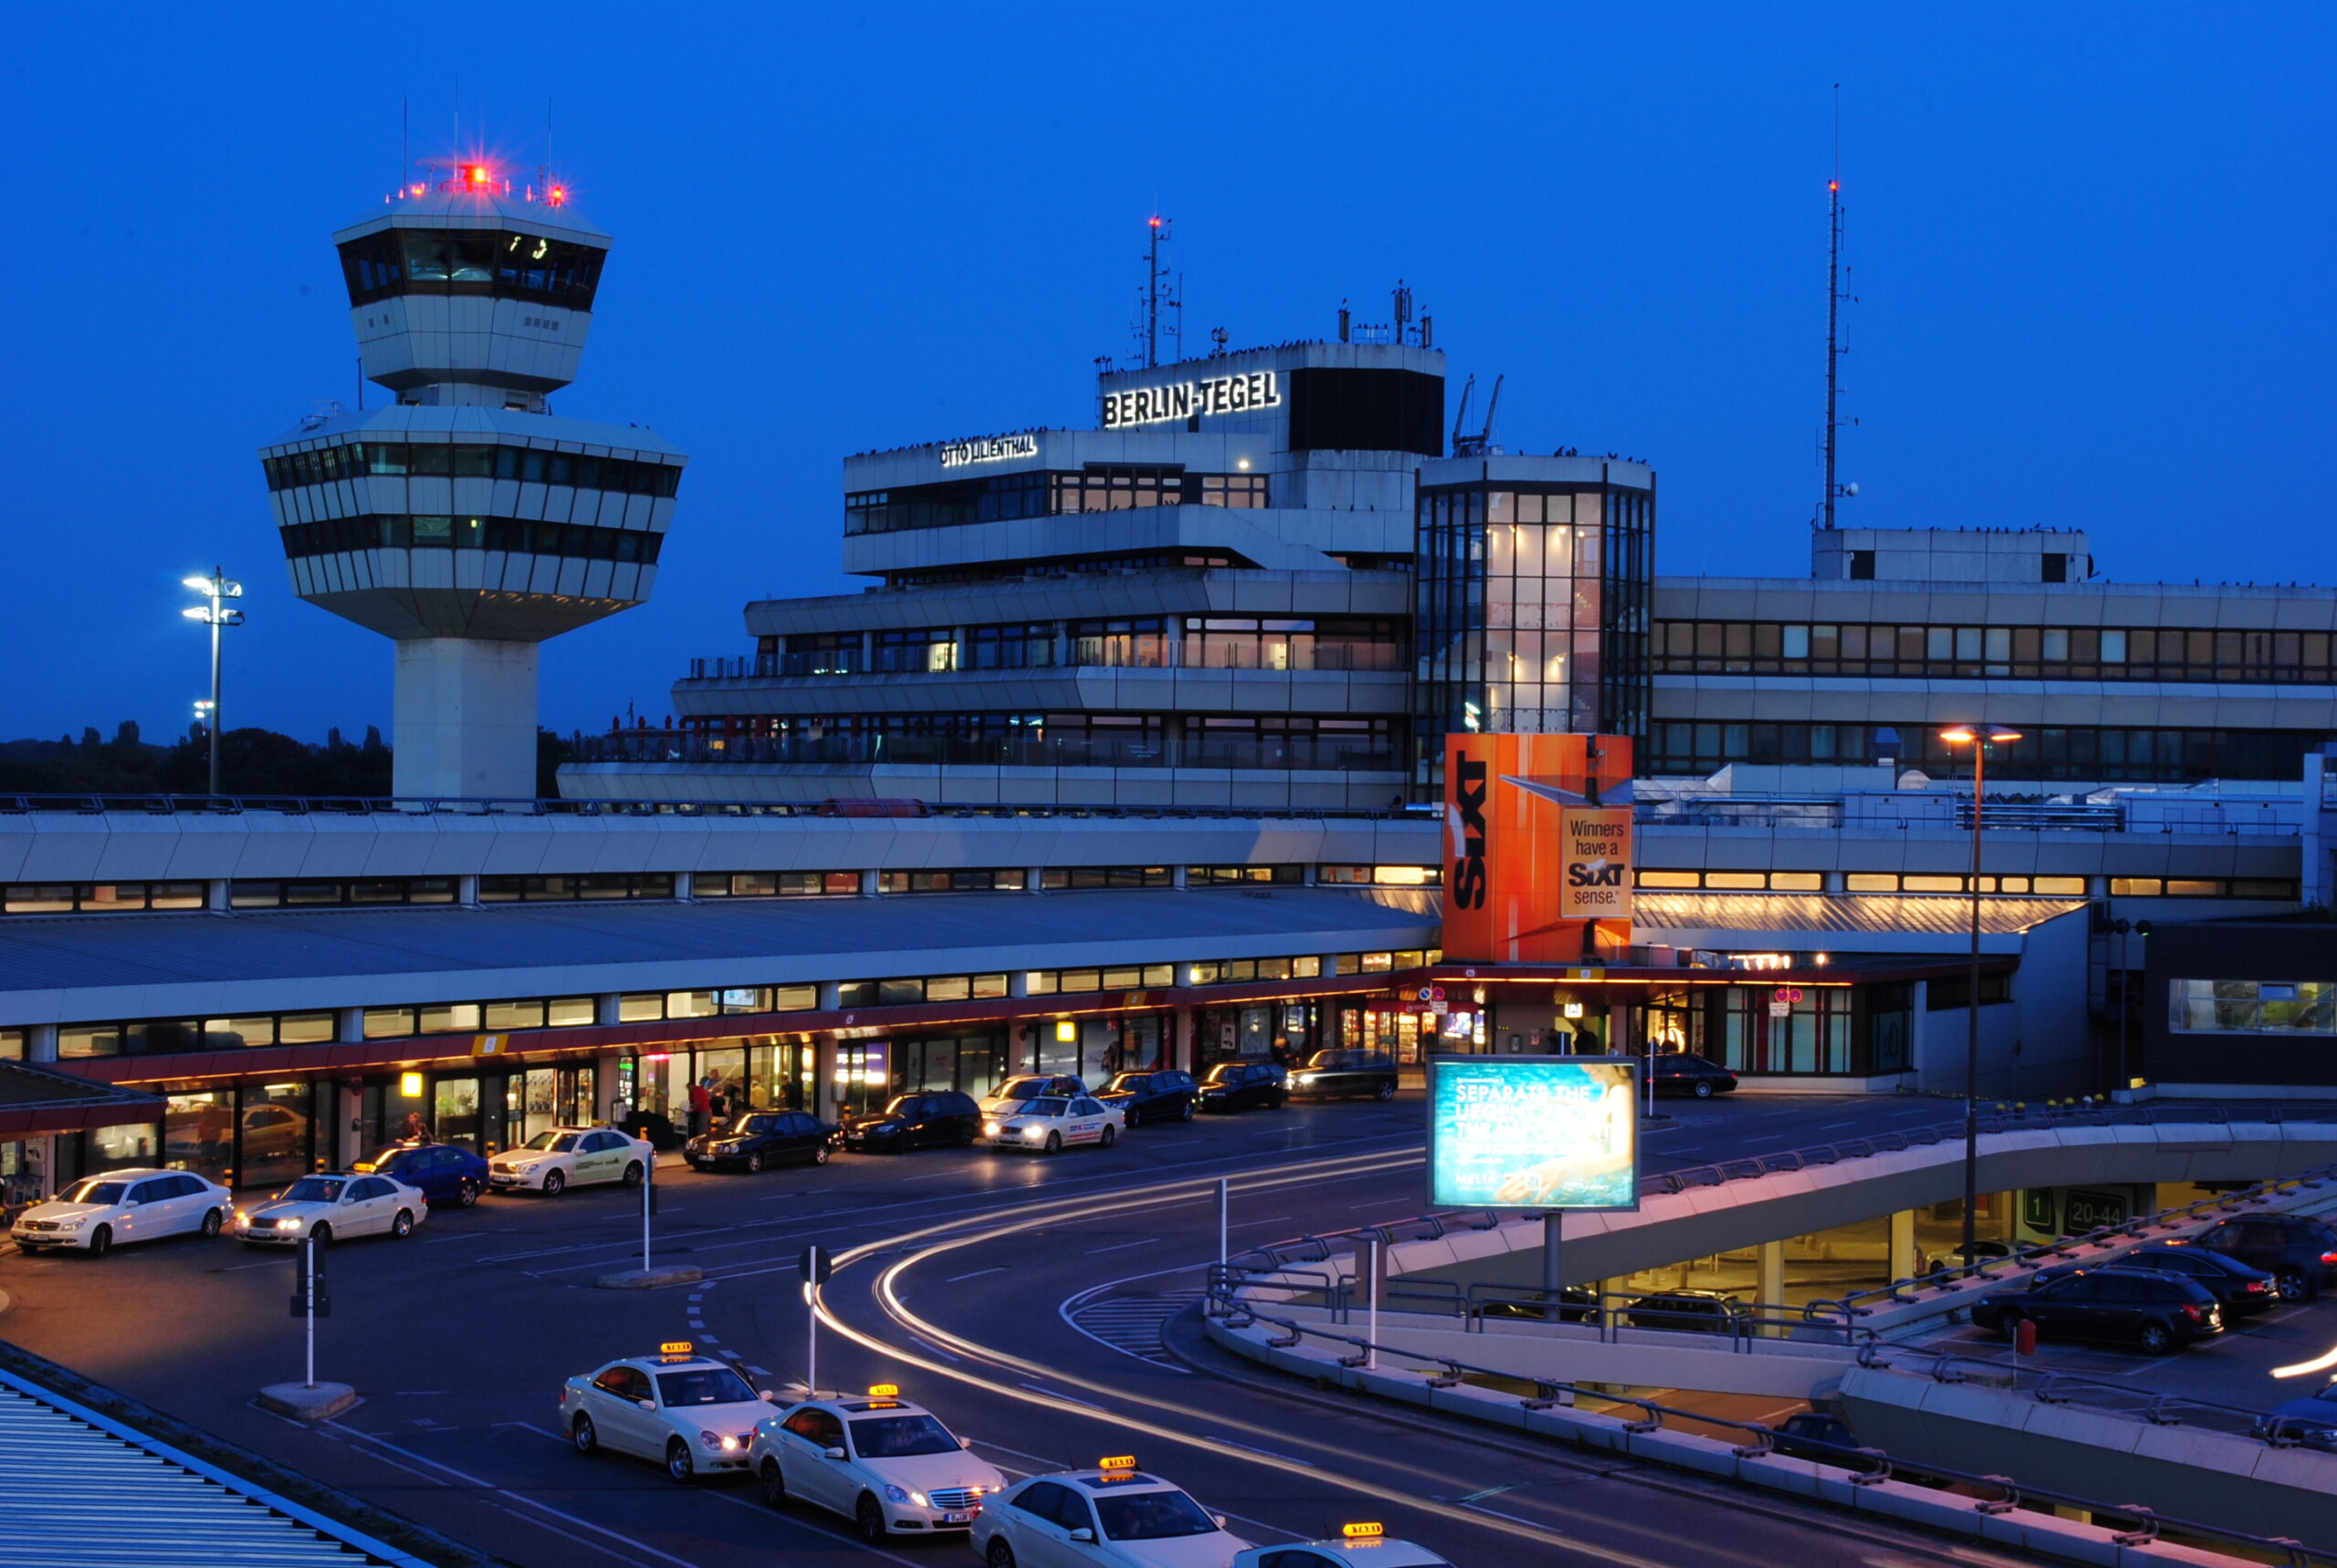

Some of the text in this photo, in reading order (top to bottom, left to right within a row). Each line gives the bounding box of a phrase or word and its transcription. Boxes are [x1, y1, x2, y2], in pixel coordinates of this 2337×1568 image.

[1103, 372, 1278, 425] BERLIN-TEGEL
[940, 435, 1036, 465] OTTO LILIENTHAL
[1451, 750, 1486, 910] SIXT
[1570, 820, 1624, 837] Winners
[1576, 840, 1618, 855] have a
[1568, 860, 1625, 887] SIXT
[1456, 1085, 1589, 1102] SEPARATE THE
[2033, 1197, 2039, 1217] 1
[2073, 1201, 2121, 1226] 20-44
